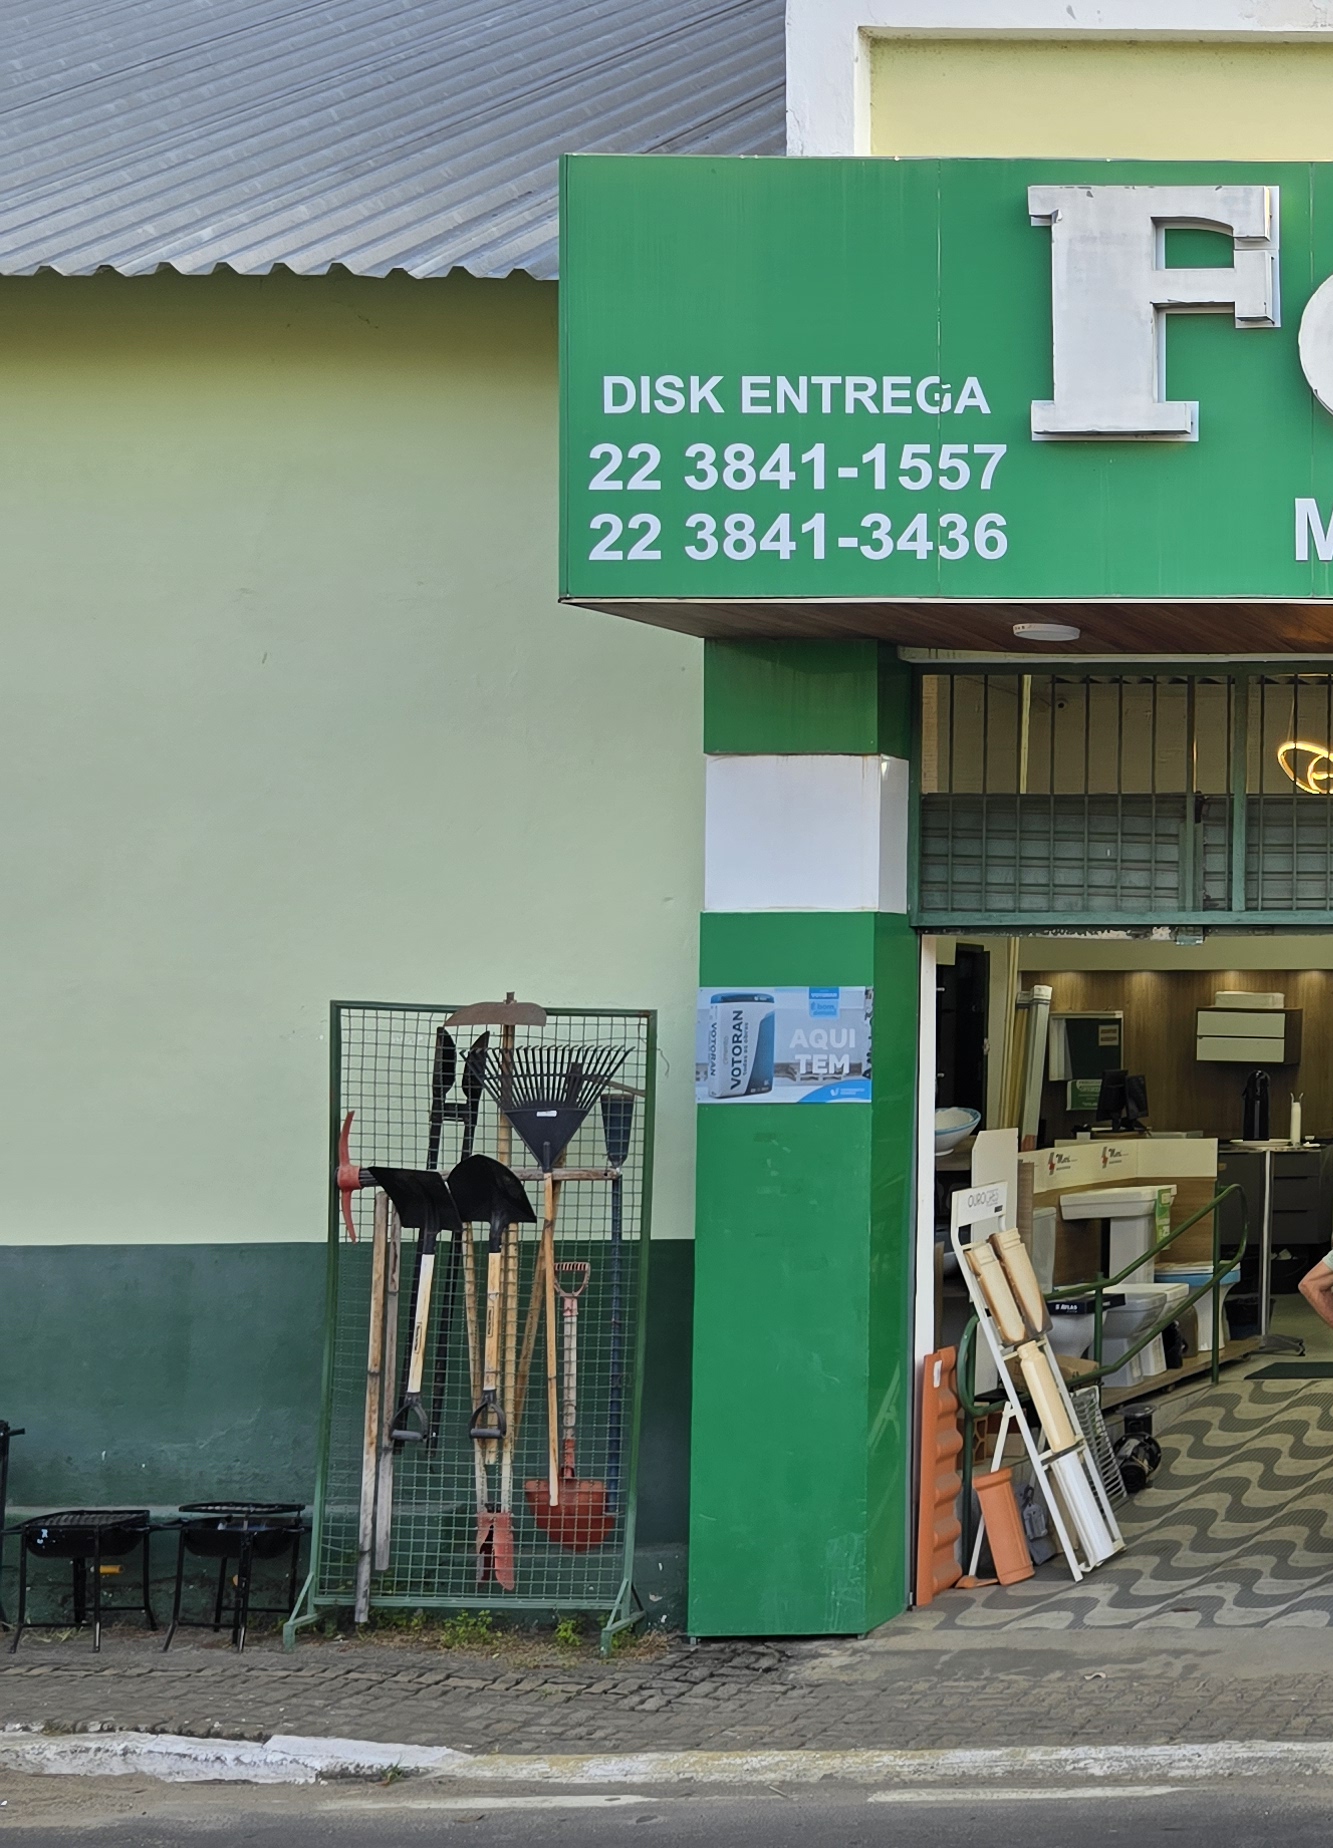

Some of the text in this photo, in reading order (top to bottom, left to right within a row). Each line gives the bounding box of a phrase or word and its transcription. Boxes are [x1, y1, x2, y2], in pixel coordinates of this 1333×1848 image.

[603, 375, 991, 414] DISK ENTREGA
[588, 443, 1007, 491] 22 3841-1557
[588, 512, 1008, 561] 22 3841-3436
[730, 1010, 743, 1090] VOTORAN
[789, 1028, 856, 1050] AQUI
[794, 1054, 850, 1074] TEM
